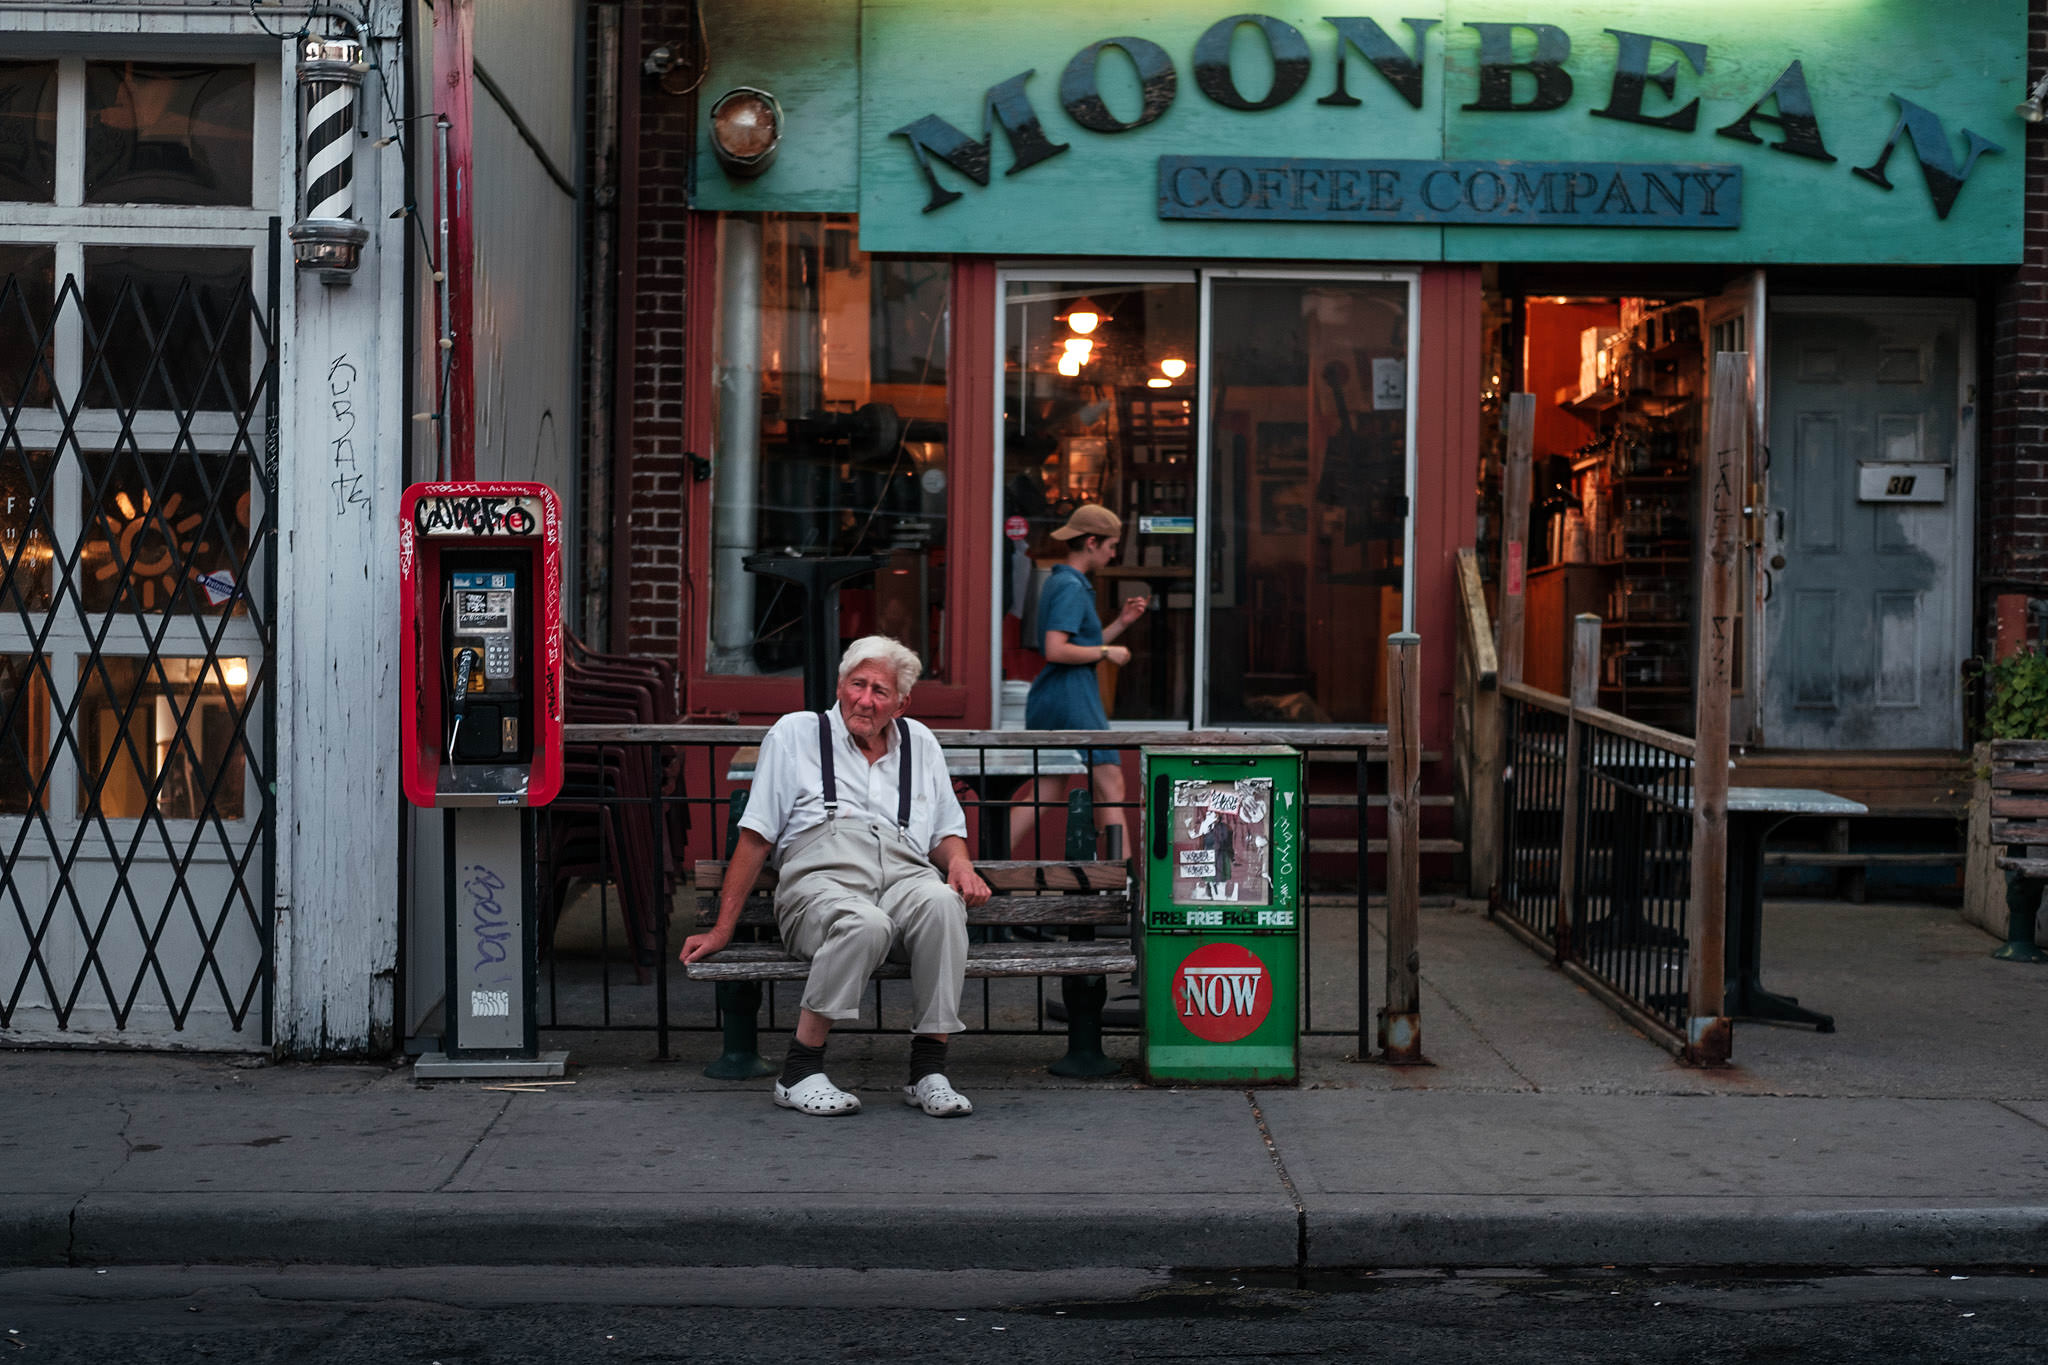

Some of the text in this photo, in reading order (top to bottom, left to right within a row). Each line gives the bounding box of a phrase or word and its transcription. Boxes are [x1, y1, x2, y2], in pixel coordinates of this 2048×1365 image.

[889, 13, 2005, 220] MOONBEAN
[1172, 165, 1736, 217] COFFEE COMPANY
[1886, 475, 1916, 496] 30
[7, 496, 16, 514] F
[1187, 911, 1223, 926] FREE
[1258, 911, 1294, 926] FREE
[1183, 974, 1262, 1017] NOW
